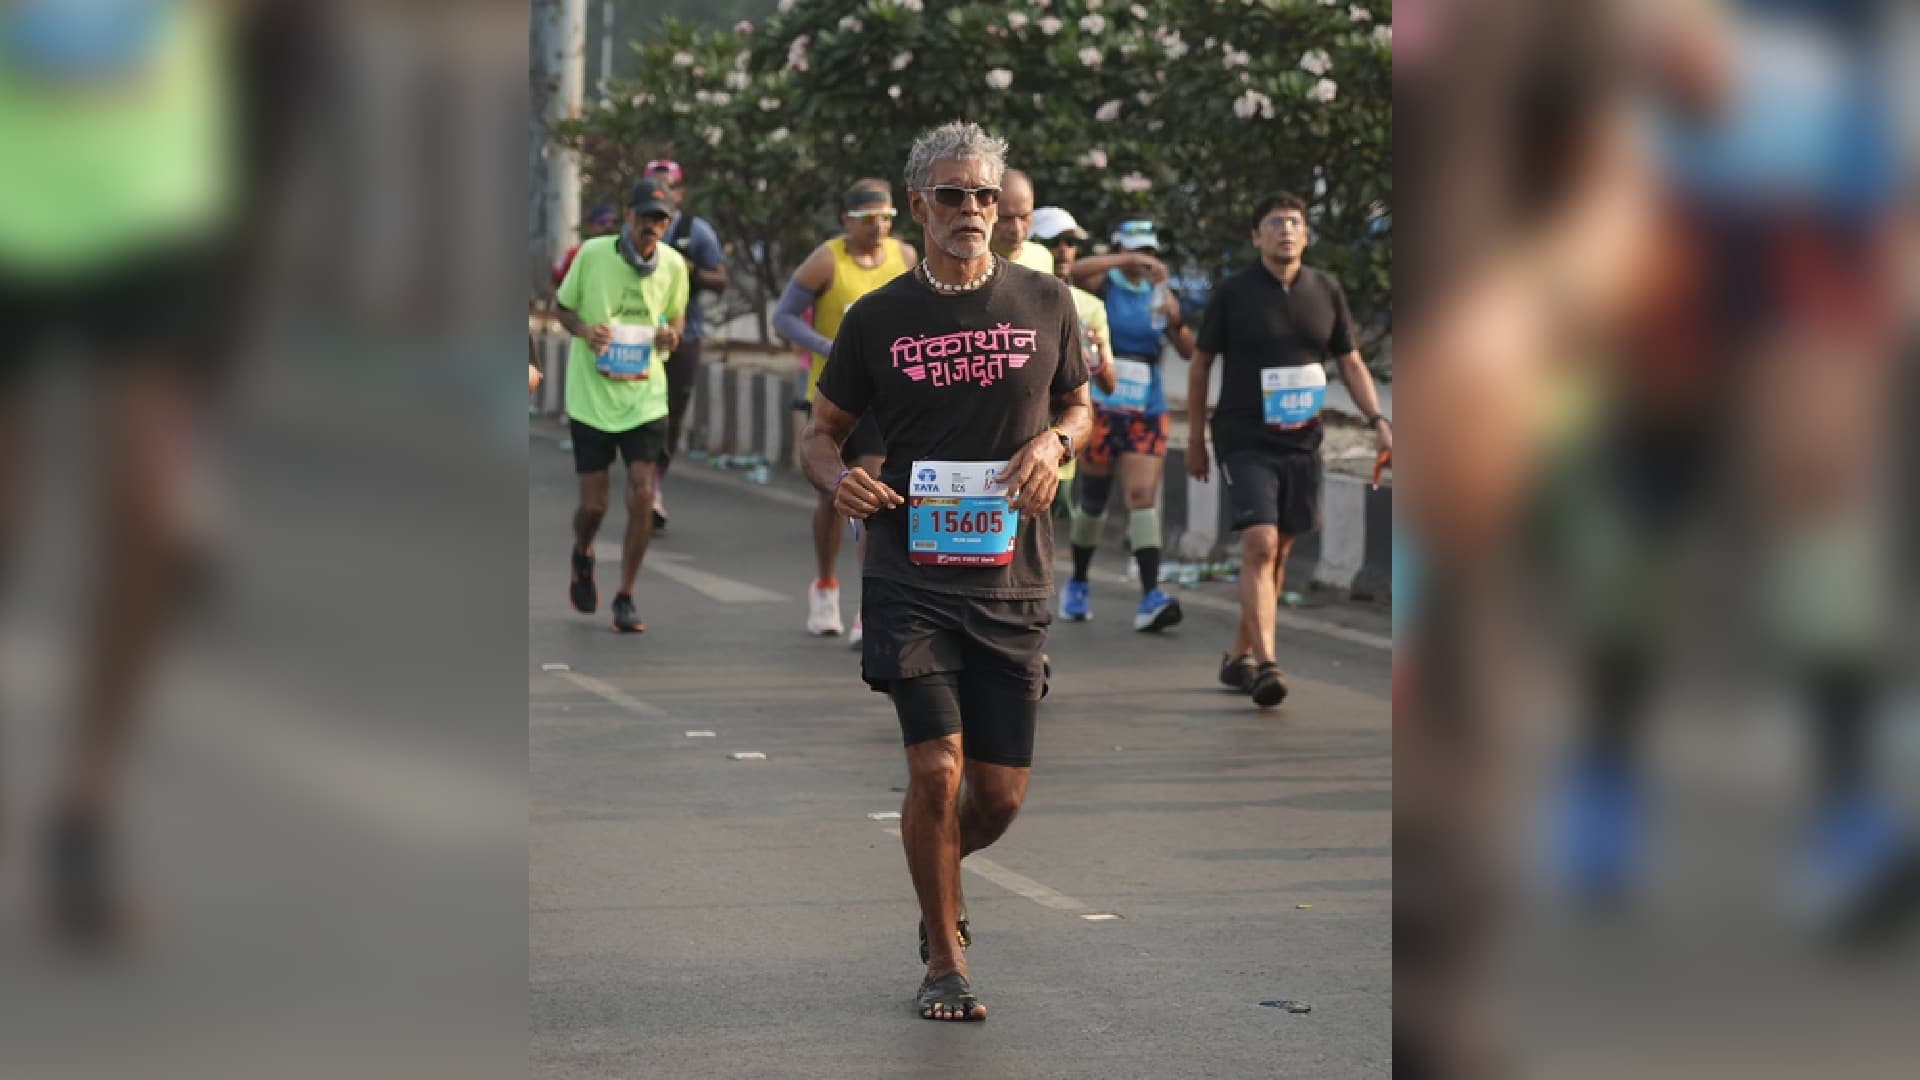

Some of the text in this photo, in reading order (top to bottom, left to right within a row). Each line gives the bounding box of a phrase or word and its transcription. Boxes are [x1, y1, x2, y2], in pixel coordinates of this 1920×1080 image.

[890, 322, 1037, 368] पिंकाथॉन
[927, 353, 1009, 388] राजदूत
[913, 483, 940, 493] TATA
[931, 510, 1004, 534] 15605
